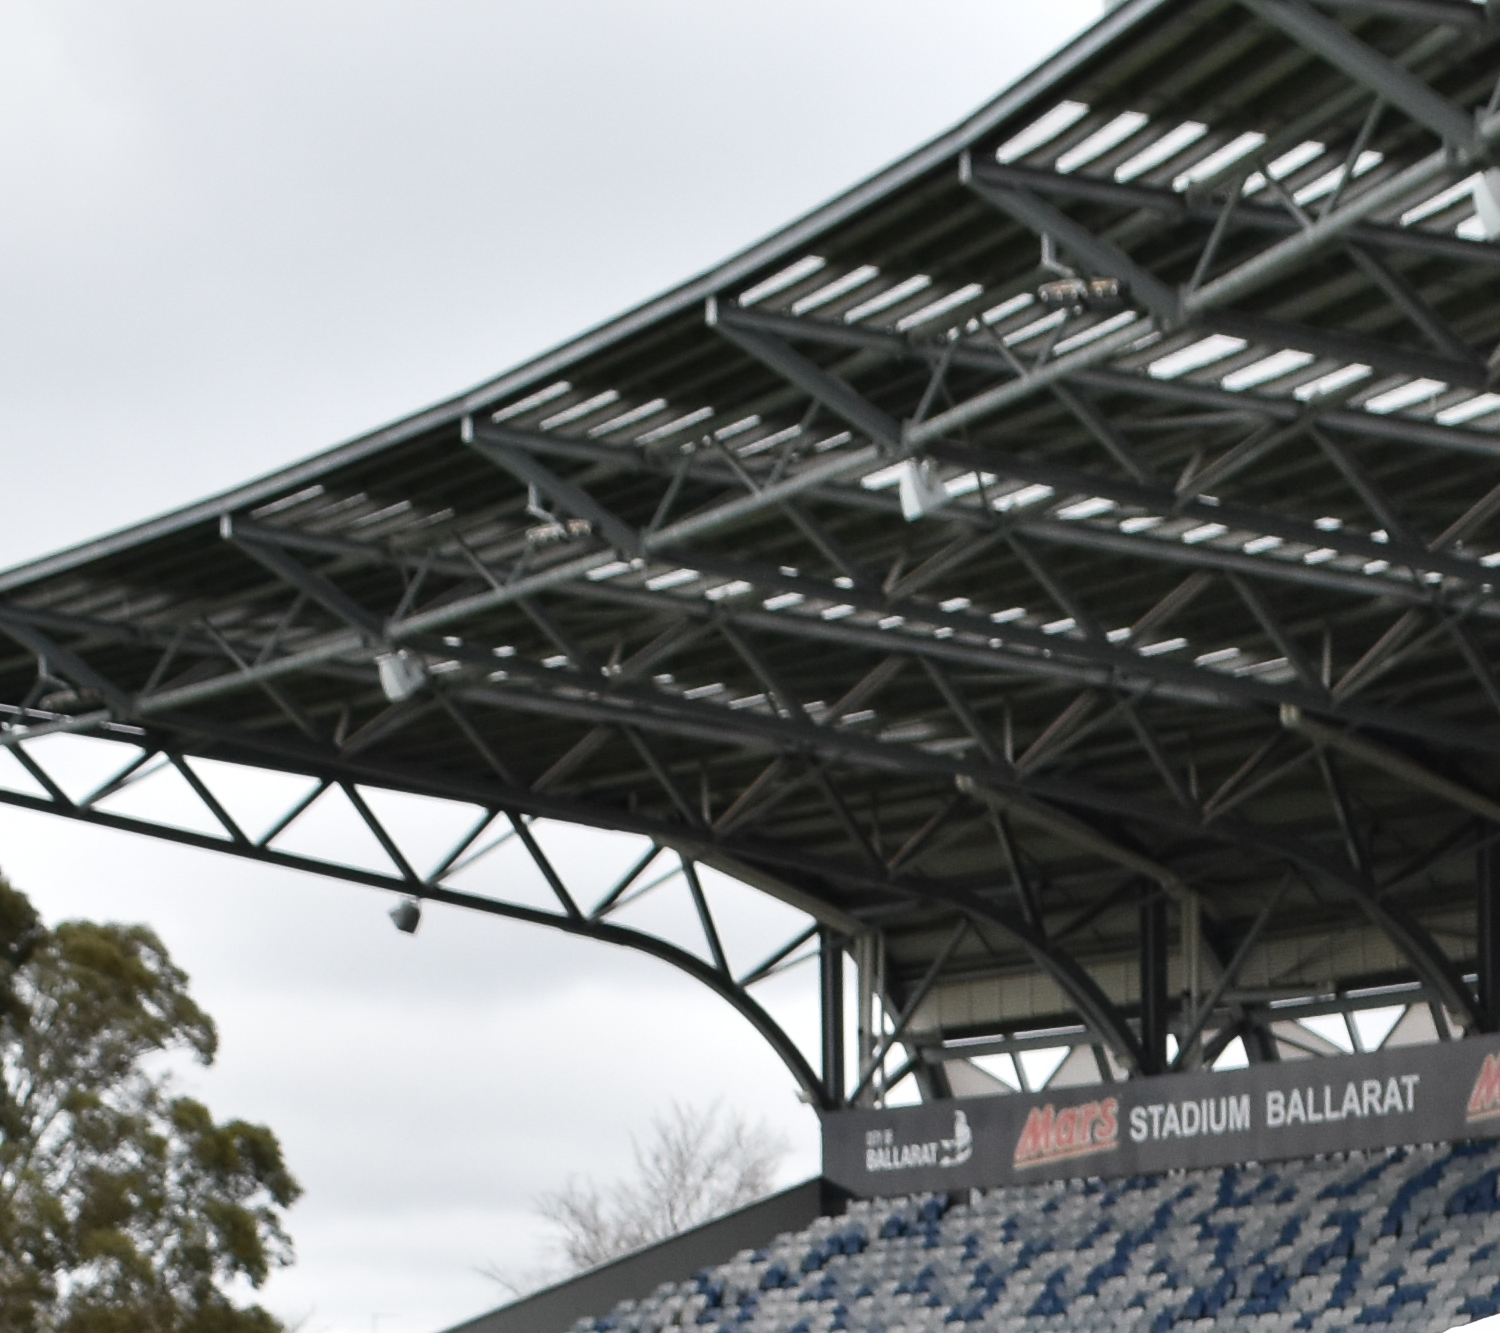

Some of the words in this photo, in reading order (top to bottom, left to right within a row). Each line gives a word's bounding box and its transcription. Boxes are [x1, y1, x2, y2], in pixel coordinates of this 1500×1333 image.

[1012, 1097, 1118, 1165] Mars
[1130, 1094, 1250, 1142] STADIUM
[1265, 1074, 1420, 1128] BALLARAT
[866, 1142, 938, 1172] BALLARAT
